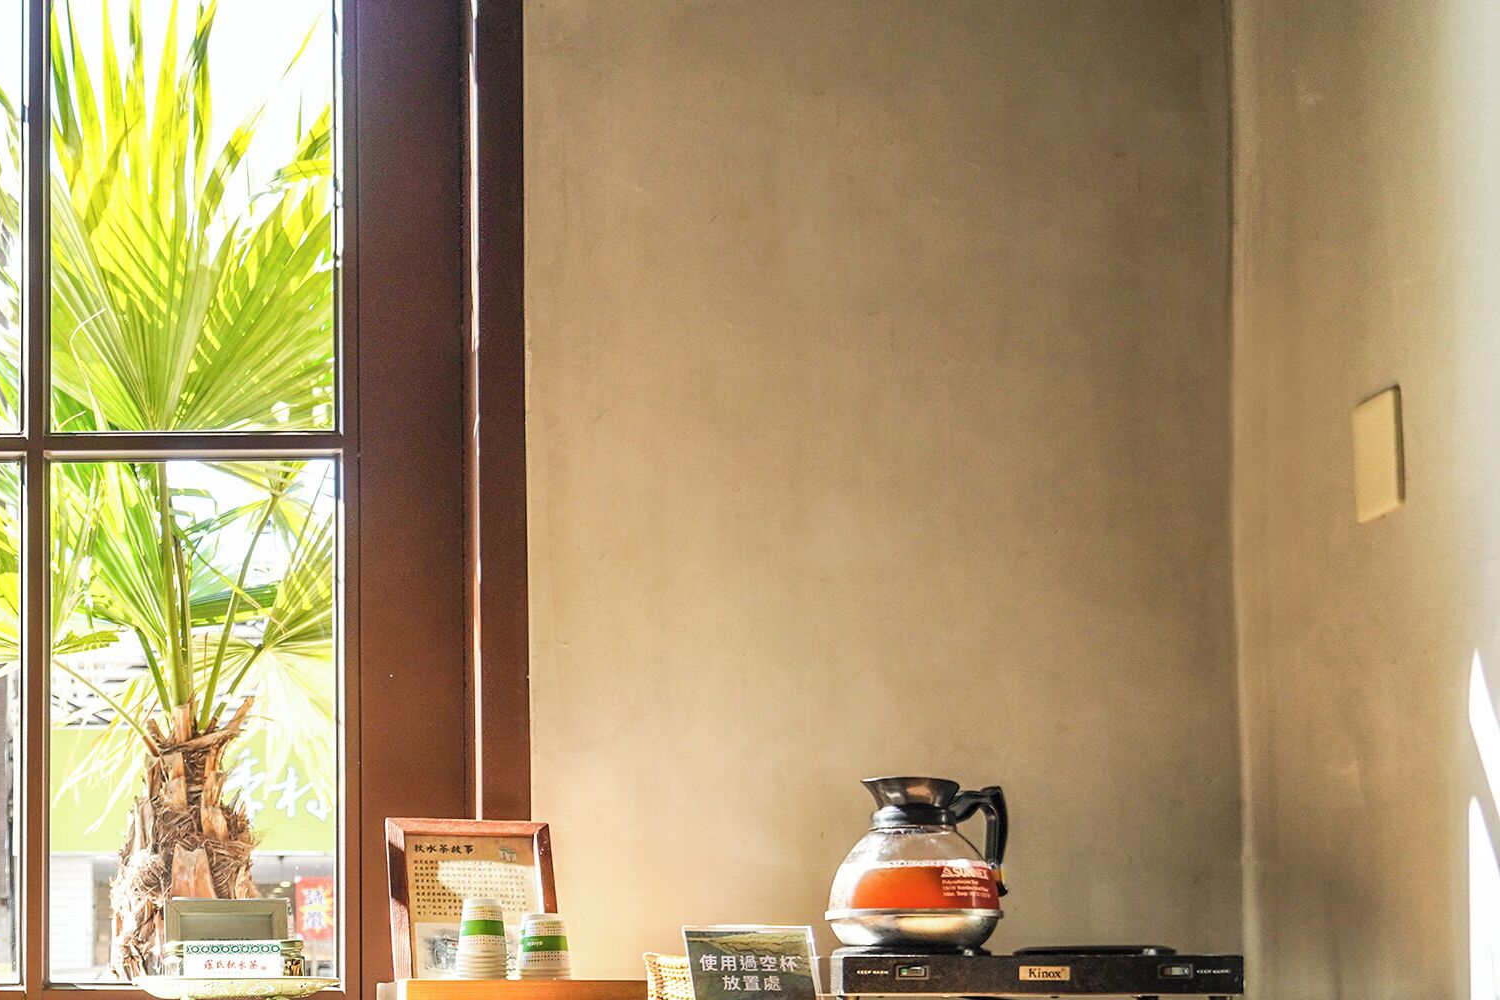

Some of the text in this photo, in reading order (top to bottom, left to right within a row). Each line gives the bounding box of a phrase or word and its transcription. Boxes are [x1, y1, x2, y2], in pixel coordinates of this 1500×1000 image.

[414, 844, 474, 854] 秋水茶故事
[699, 954, 798, 972] 使用過空杯
[1028, 967, 1062, 979] Kinox
[722, 975, 782, 991] 放置處
